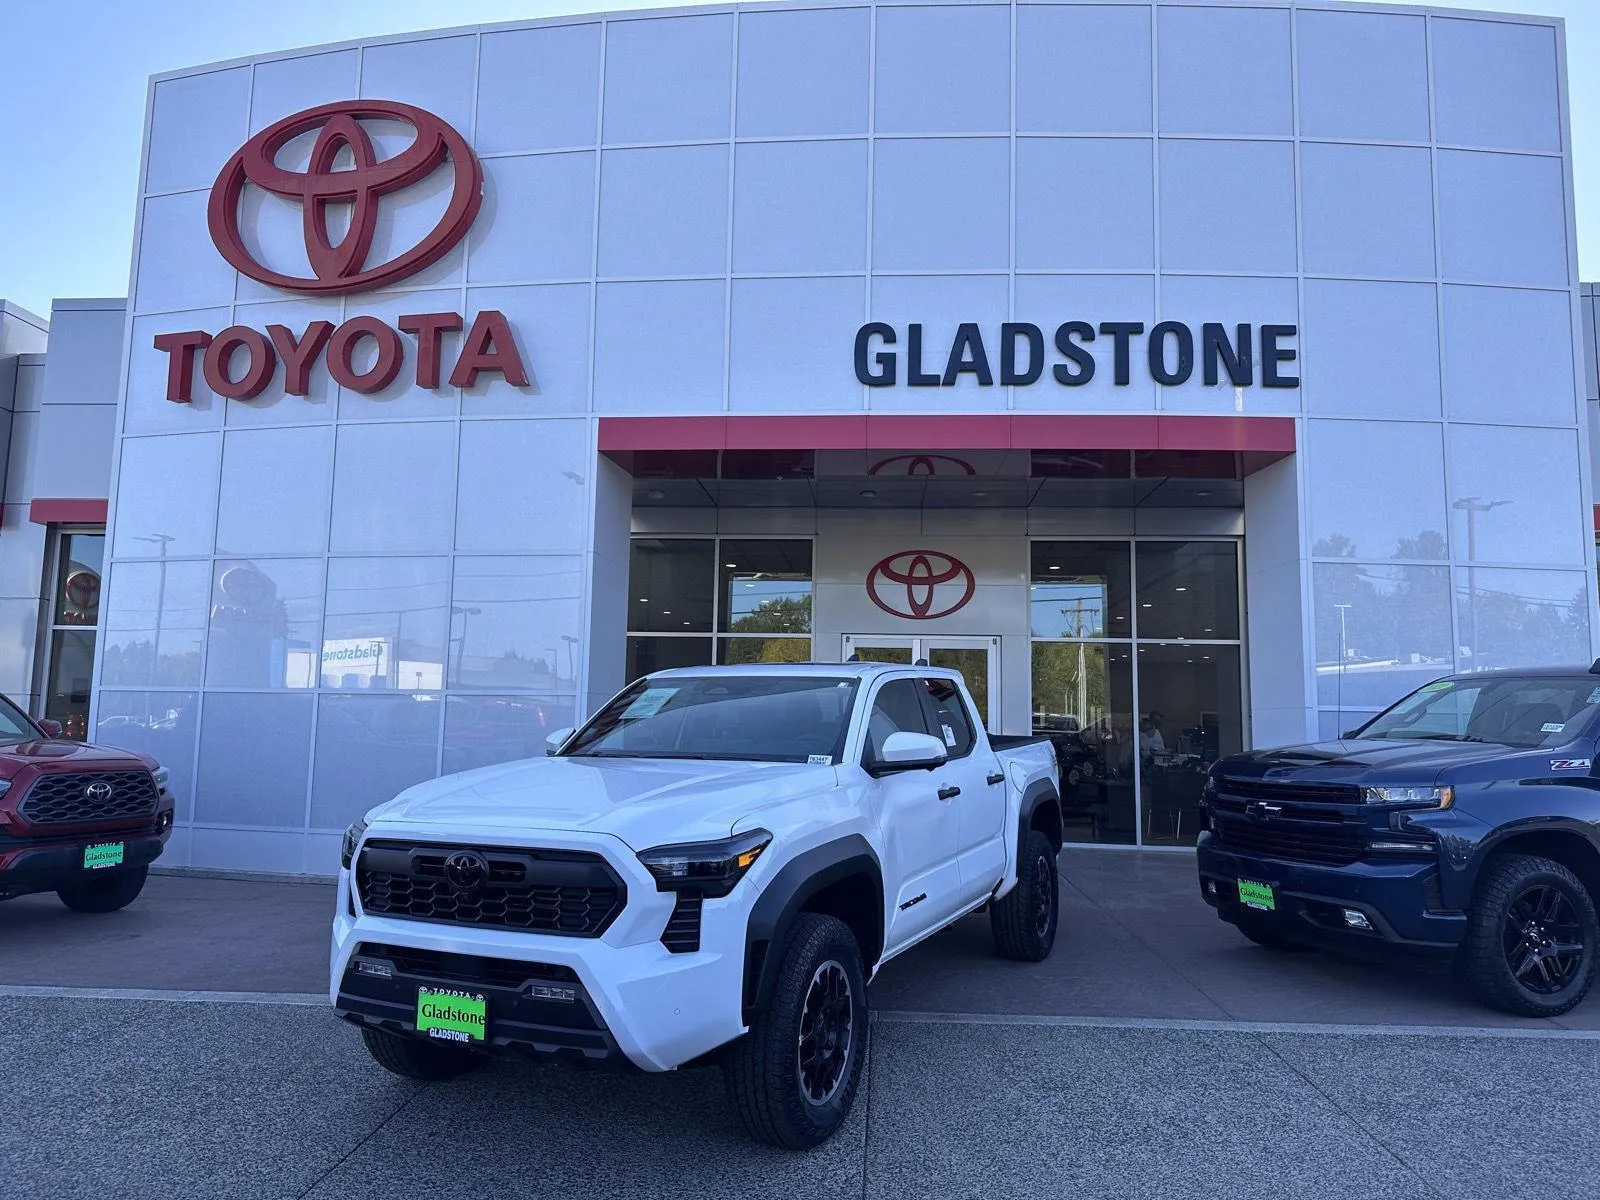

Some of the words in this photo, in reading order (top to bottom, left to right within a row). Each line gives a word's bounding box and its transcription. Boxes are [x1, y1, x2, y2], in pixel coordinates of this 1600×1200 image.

[154, 311, 531, 402] TOYOTA
[854, 321, 1301, 388] GLADSTONE
[86, 851, 122, 861] Gladstone
[1240, 888, 1273, 902] Gladstone
[433, 987, 471, 999] TOYOTA
[421, 1003, 486, 1026] Gladstone
[429, 1028, 470, 1042] GLADSTONE
